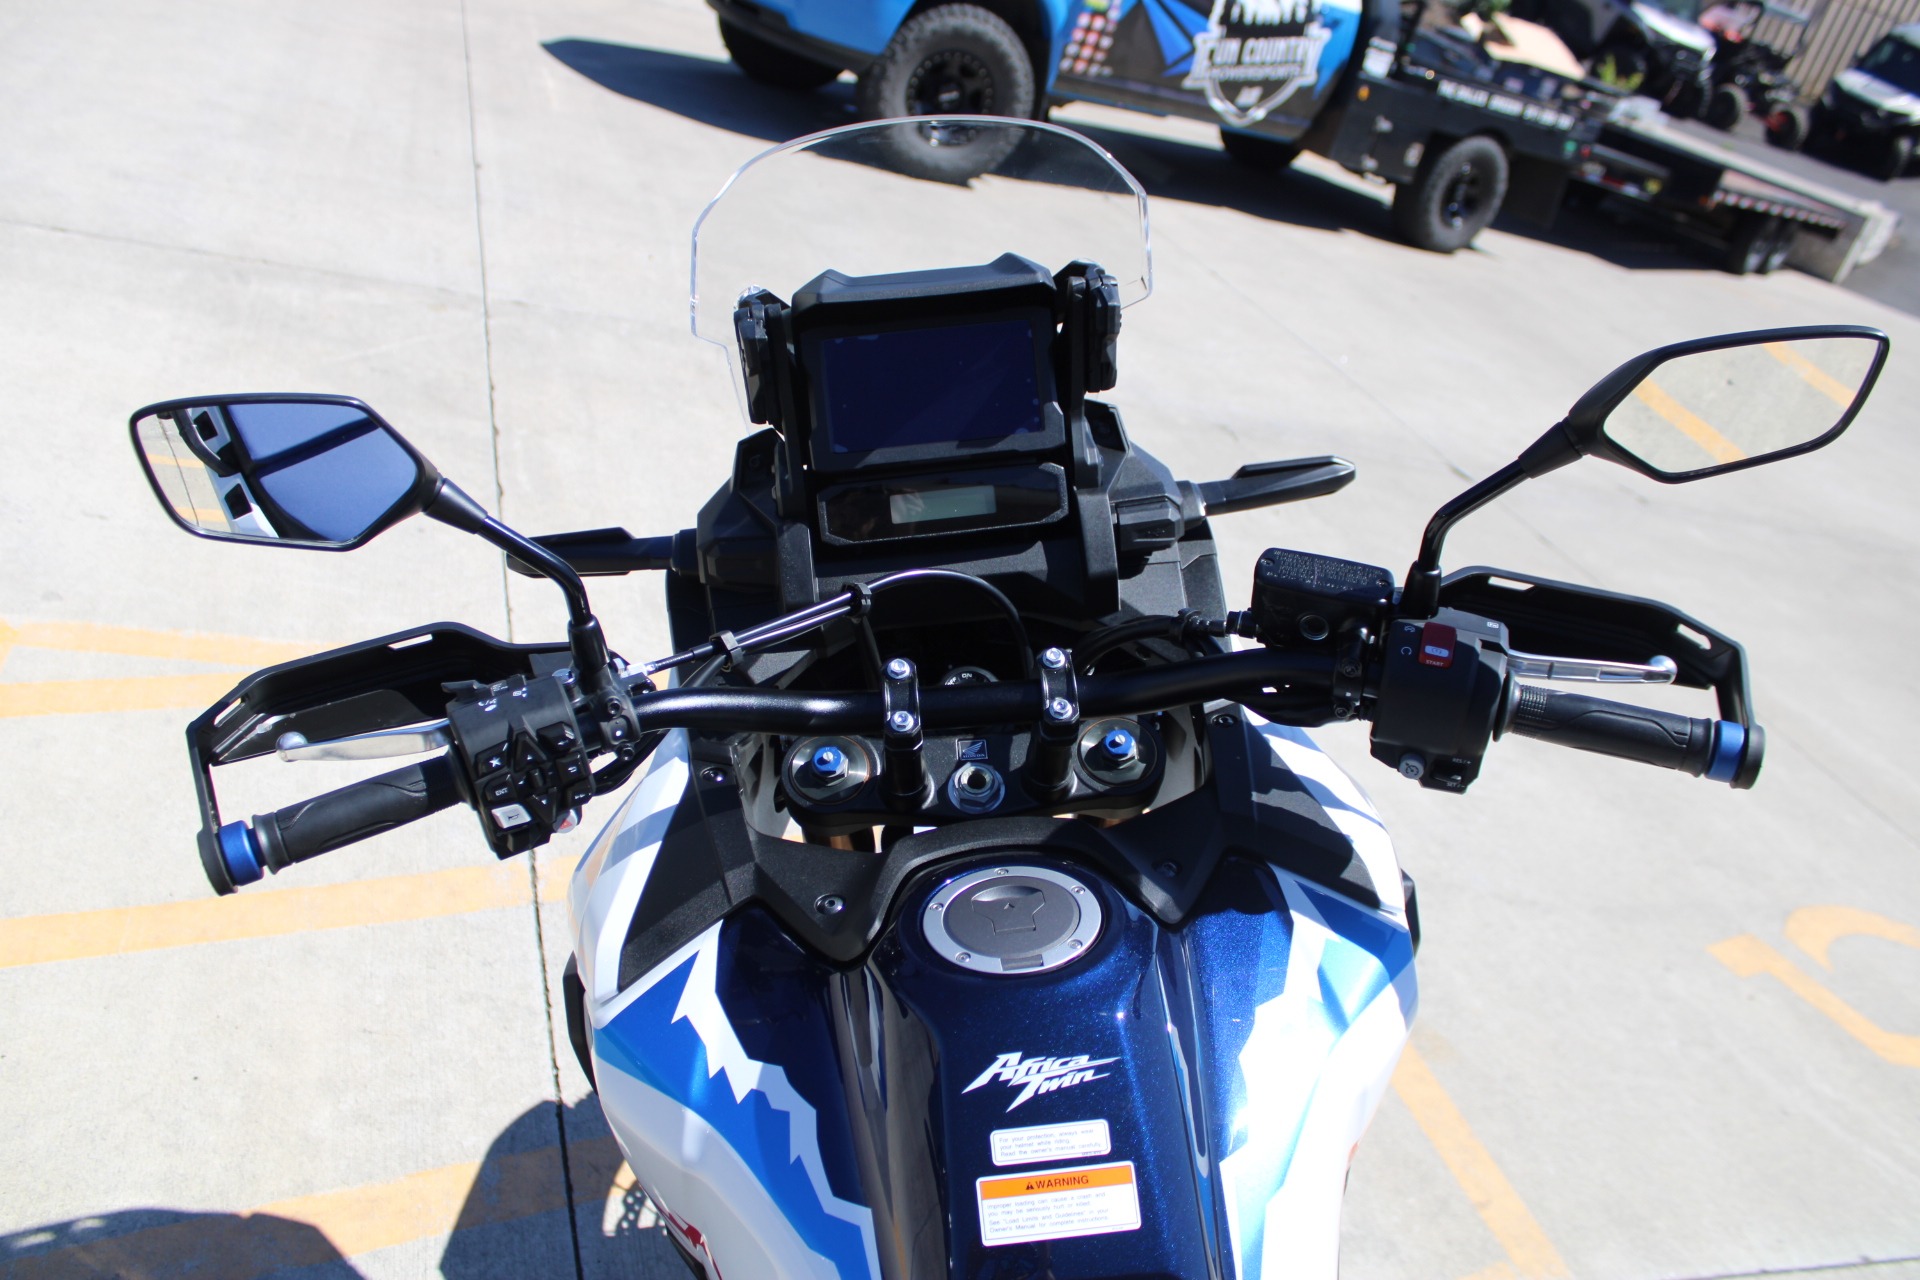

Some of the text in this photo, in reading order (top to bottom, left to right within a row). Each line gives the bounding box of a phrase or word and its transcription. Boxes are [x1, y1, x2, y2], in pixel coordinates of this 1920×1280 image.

[1192, 37, 1242, 74] FUN
[1241, 36, 1322, 74] COUNTRY
[495, 788, 508, 796] ENT
[962, 1052, 1122, 1094] Africa
[1006, 1068, 1111, 1113] Twin
[1036, 1175, 1089, 1189] WARNING
[1049, 1219, 1074, 1227] complete
